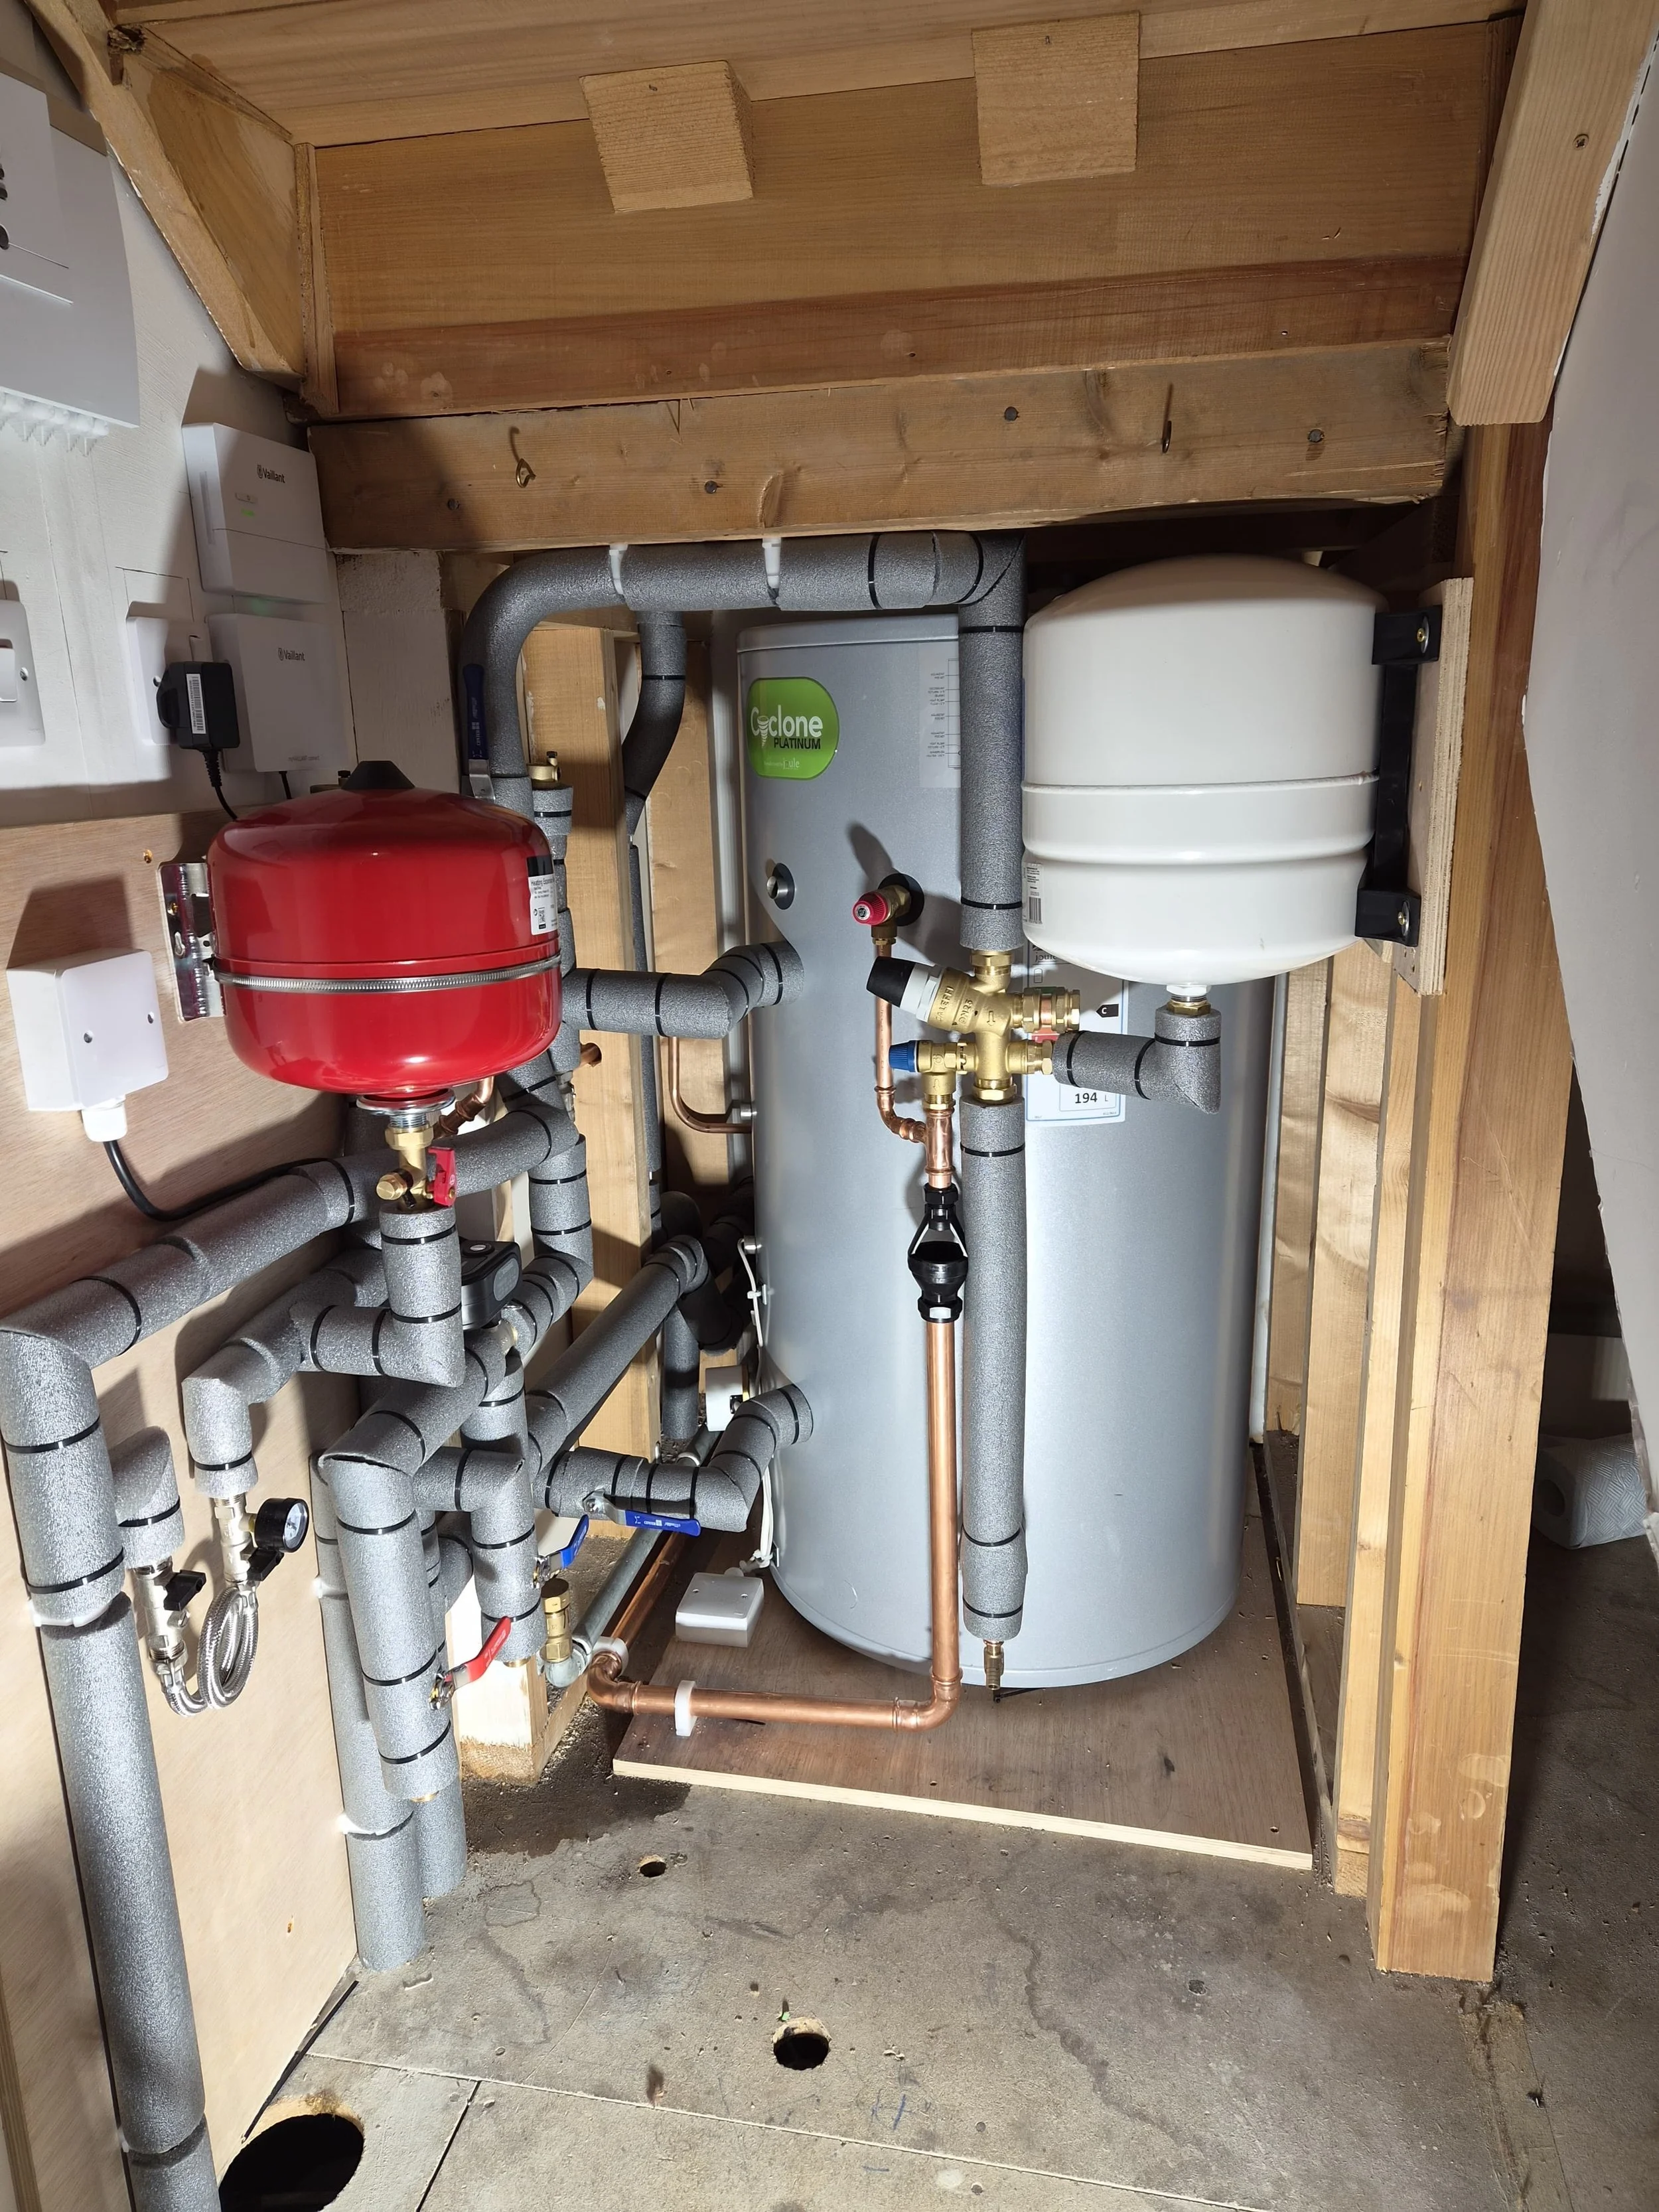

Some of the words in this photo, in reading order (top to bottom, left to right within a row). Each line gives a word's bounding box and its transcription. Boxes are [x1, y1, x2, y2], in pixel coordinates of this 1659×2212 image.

[263, 467, 285, 484] Vaillant
[283, 649, 305, 662] Vaillant
[774, 737, 821, 750] PLATINUM
[1074, 1092, 1098, 1104] 194
